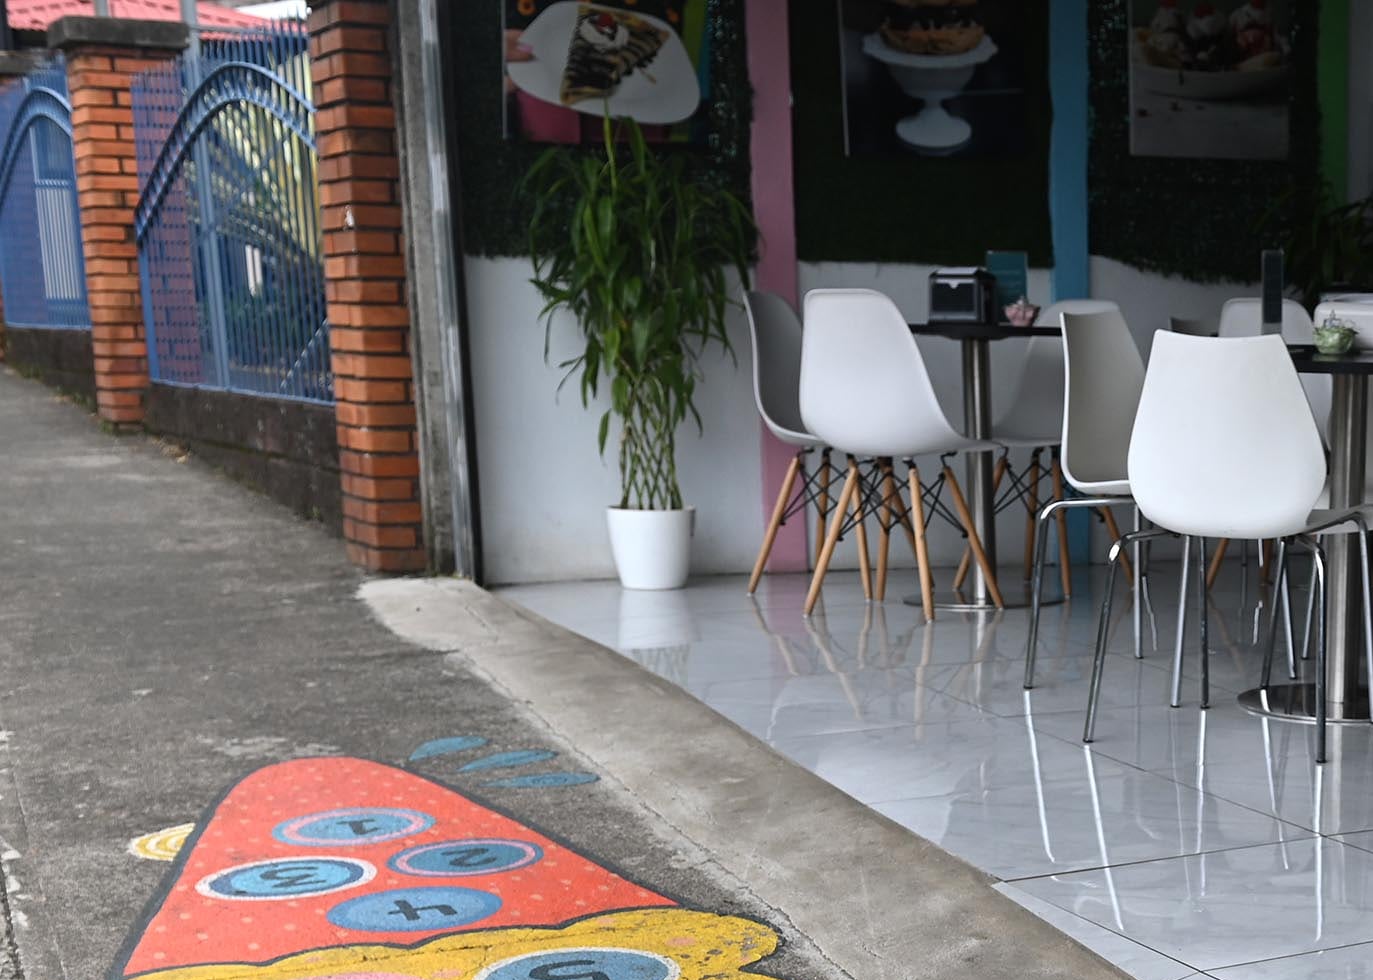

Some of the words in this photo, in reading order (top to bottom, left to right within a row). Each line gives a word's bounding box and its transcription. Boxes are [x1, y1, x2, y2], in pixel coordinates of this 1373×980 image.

[335, 817, 380, 836] 1
[441, 846, 498, 868] 2
[259, 865, 327, 889] 3
[387, 899, 459, 922] 4
